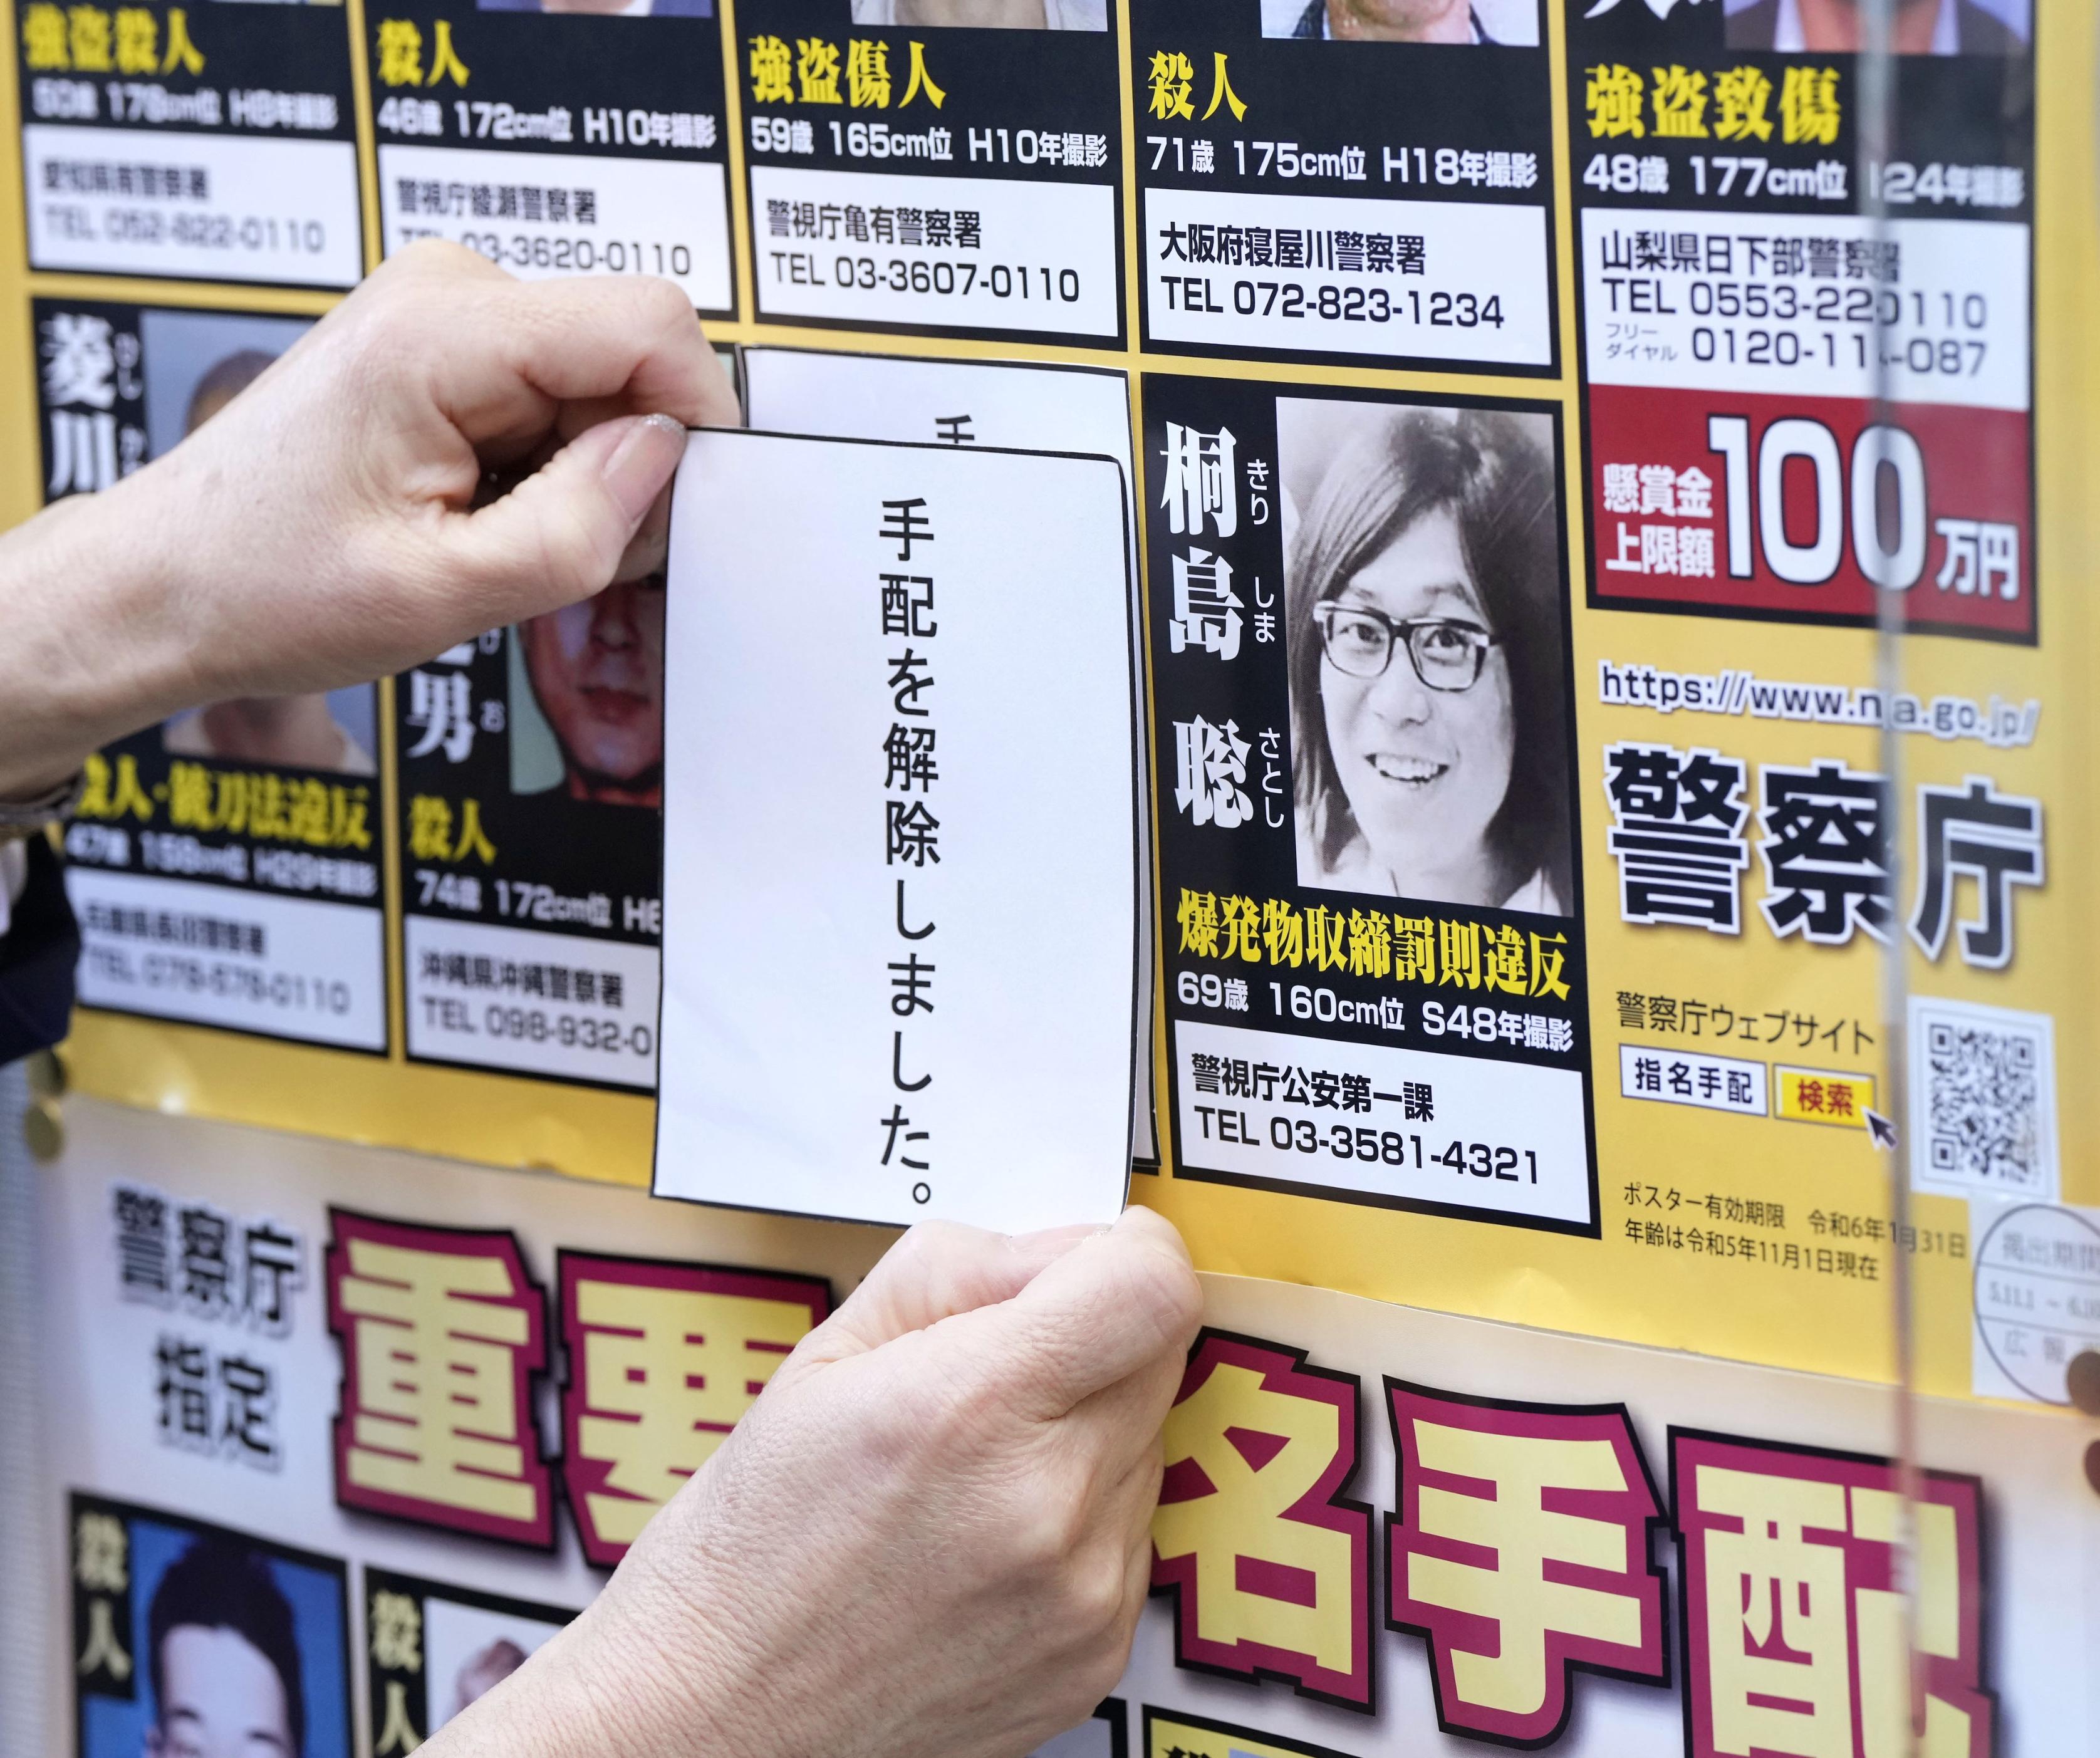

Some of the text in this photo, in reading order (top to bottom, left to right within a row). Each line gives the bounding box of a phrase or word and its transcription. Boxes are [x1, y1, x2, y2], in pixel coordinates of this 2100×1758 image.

[377, 18, 471, 88] 殺人
[748, 34, 946, 110] 強盗傷人
[1148, 49, 1247, 123] 殺人
[1585, 63, 1841, 145] 強盗致傷
[377, 96, 717, 149] 46歳 172cm位 H10年撮影
[751, 116, 1108, 168] 59歳 165cm位 H10年撮影
[1145, 137, 1538, 189] 71歳 175cm位 H18年撮影
[1583, 154, 1670, 195] 48歳
[1690, 156, 1848, 200] 177cm位
[44, 205, 97, 241] TEL
[395, 176, 597, 224] 警視庁綾瀬警察署
[766, 199, 981, 249] 警視庁亀有警察署
[770, 252, 1080, 302] TEL 03-3607-0110
[1159, 221, 1426, 275] 大阪府寝屋川警察署
[1161, 276, 1504, 330] TEL 072-823-1234
[1601, 278, 1988, 330] TEL 0553-220110
[1605, 323, 1659, 340] フリー
[1605, 327, 1989, 376] ダイヤル 0120-11-087
[1603, 463, 1714, 519] 懸賞金
[1604, 522, 1716, 580] 上限額
[1159, 420, 1254, 830] 桐島 聡
[1246, 459, 1285, 828] きり しま さとし
[406, 640, 477, 764] 男
[1600, 663, 2040, 743] https://www.na.go.jp/
[407, 792, 497, 865] 殺人
[878, 497, 941, 1205] 手配を解除しました。
[1604, 740, 2045, 969] 警察庁
[414, 868, 482, 912] 74歳
[494, 880, 613, 930] 172cm位
[1177, 888, 1571, 1001] 爆発物取締罰則違反
[420, 947, 625, 1009] 沖縄県沖縄警察署
[421, 996, 652, 1056] TEL 098-932-0
[1177, 971, 1574, 1053] 69歳 160cm位 S48年撮影
[1616, 991, 1875, 1056] 警察庁ウェブサイト
[1192, 1053, 1435, 1123] 警視庁公安第一課
[1635, 1057, 1854, 1118] 指名手配 検索
[1194, 1106, 1538, 1185] TEL 03-3581-4321
[1623, 1181, 1967, 1259] ポスター有効期限 令和6年1月31日
[1624, 1218, 1880, 1282] 年齢は令和5年11月1日現在
[113, 1185, 304, 1329] 警察庁
[153, 1334, 277, 1463] 指定
[76, 1512, 133, 1681] 殺人
[370, 1589, 425, 1757] 殺人
